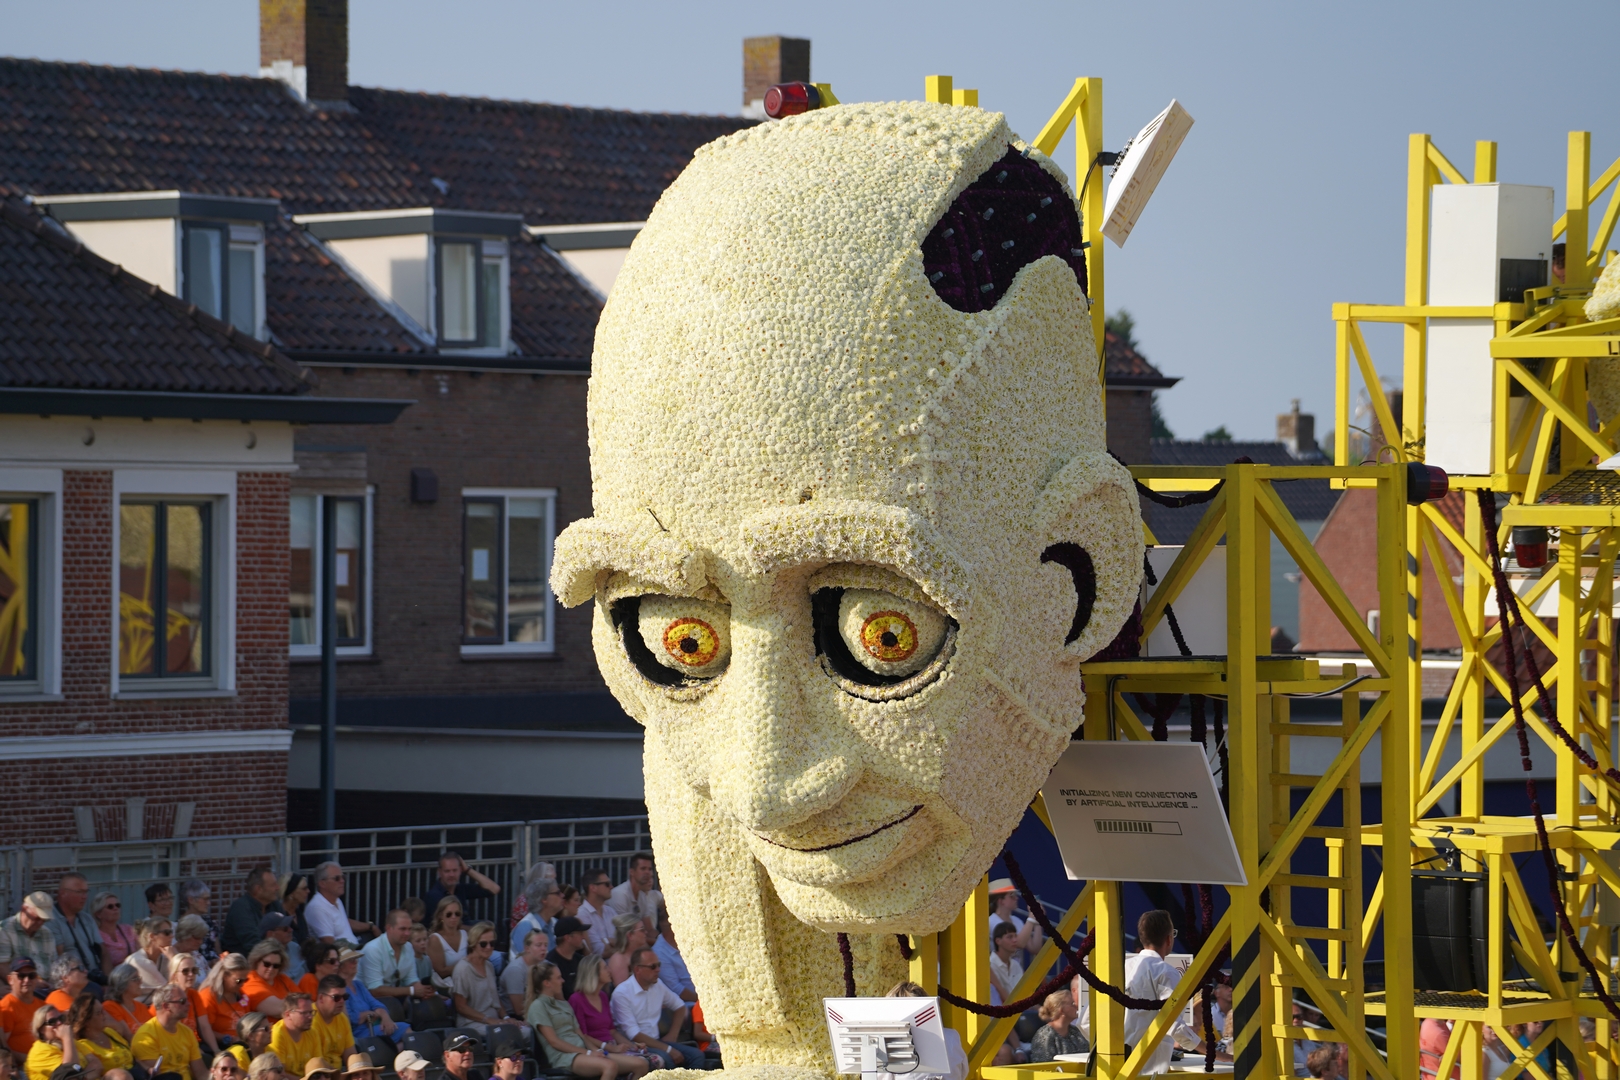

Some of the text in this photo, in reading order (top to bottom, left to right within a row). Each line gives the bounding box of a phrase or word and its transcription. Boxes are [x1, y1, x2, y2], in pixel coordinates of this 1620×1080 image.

[1059, 789, 1198, 799] INITIALIZING NEW CONNECTIONS
[1081, 799, 1126, 808] ARTIFICIAL
[1128, 801, 1189, 809] INTELLIGENCE
